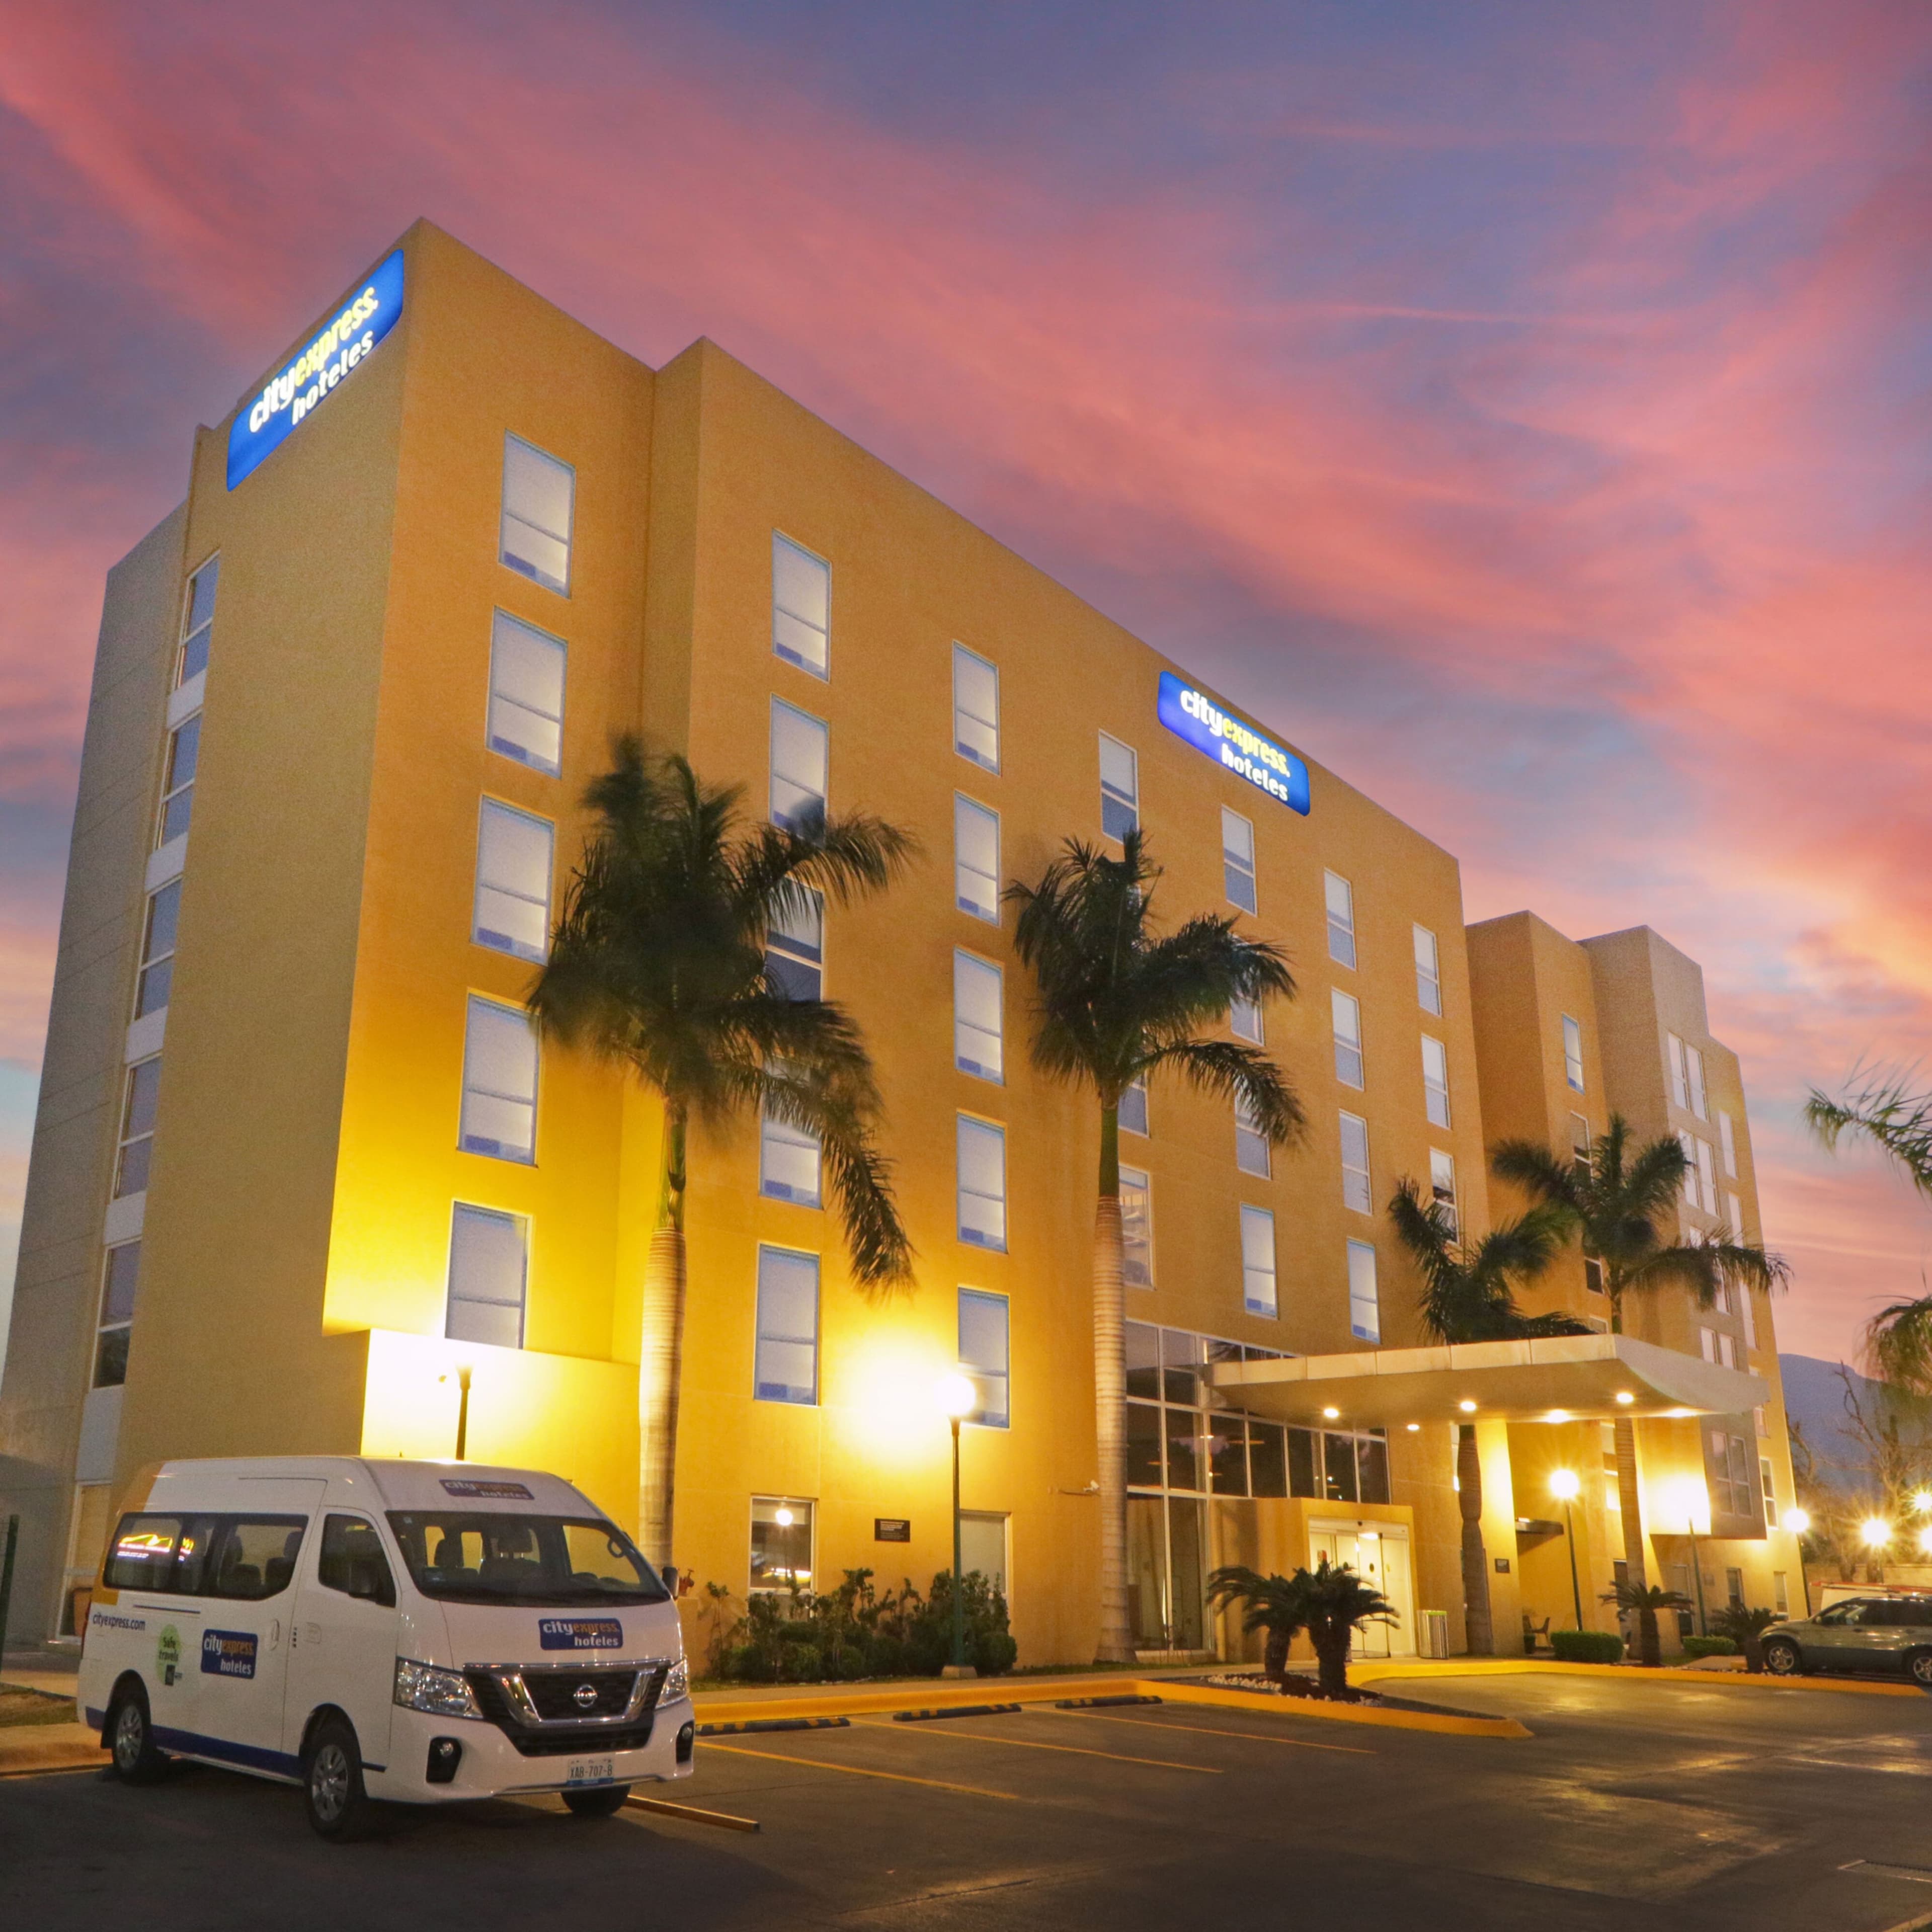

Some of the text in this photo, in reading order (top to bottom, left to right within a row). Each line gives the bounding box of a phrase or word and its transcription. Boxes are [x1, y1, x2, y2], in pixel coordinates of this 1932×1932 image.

[1221, 743, 1289, 801] hoteles
[93, 1612, 145, 1631] cityexpress.com
[574, 1636, 619, 1647] hoteles
[220, 1658, 252, 1675] hoteles
